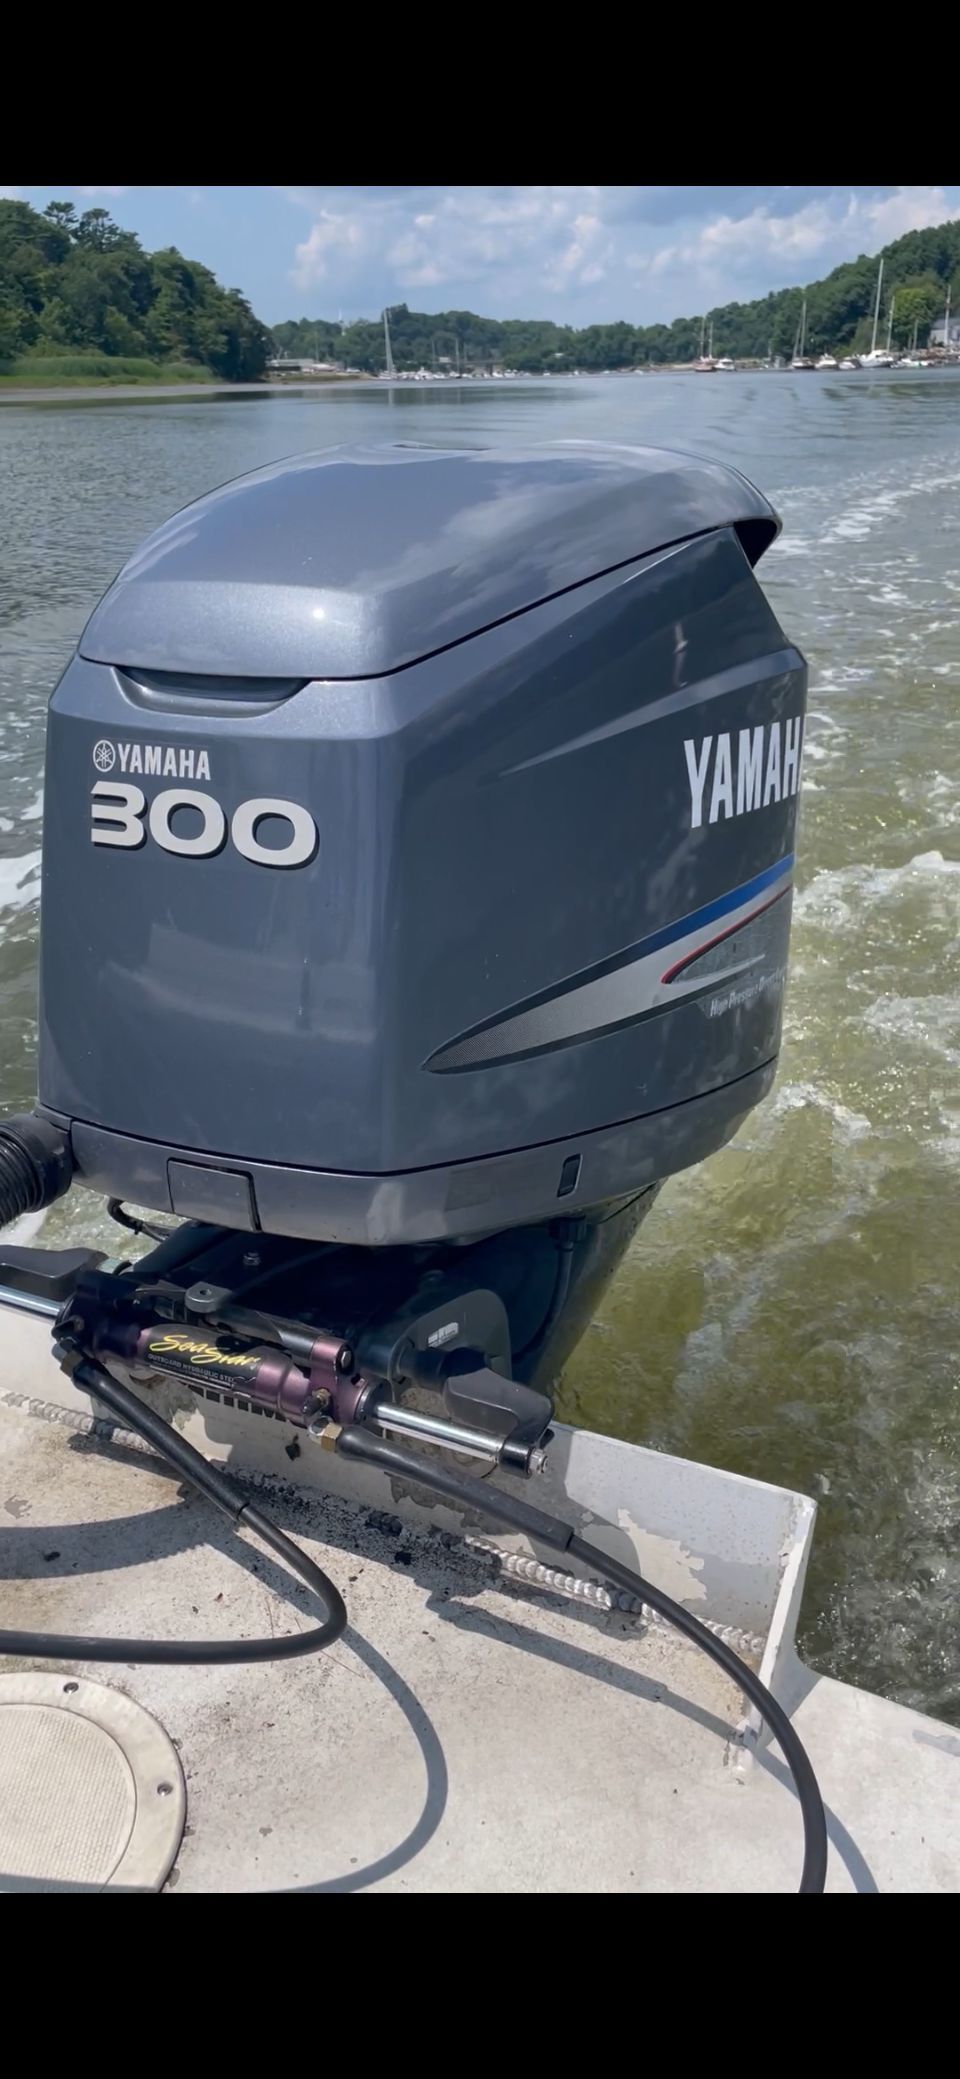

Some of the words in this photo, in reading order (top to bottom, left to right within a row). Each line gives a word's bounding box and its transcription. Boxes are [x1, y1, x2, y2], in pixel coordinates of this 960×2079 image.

[117, 743, 211, 781] YAMAHA
[684, 716, 800, 828] YAMAH
[91, 781, 319, 870] 300
[149, 1334, 256, 1365] SeaStar
